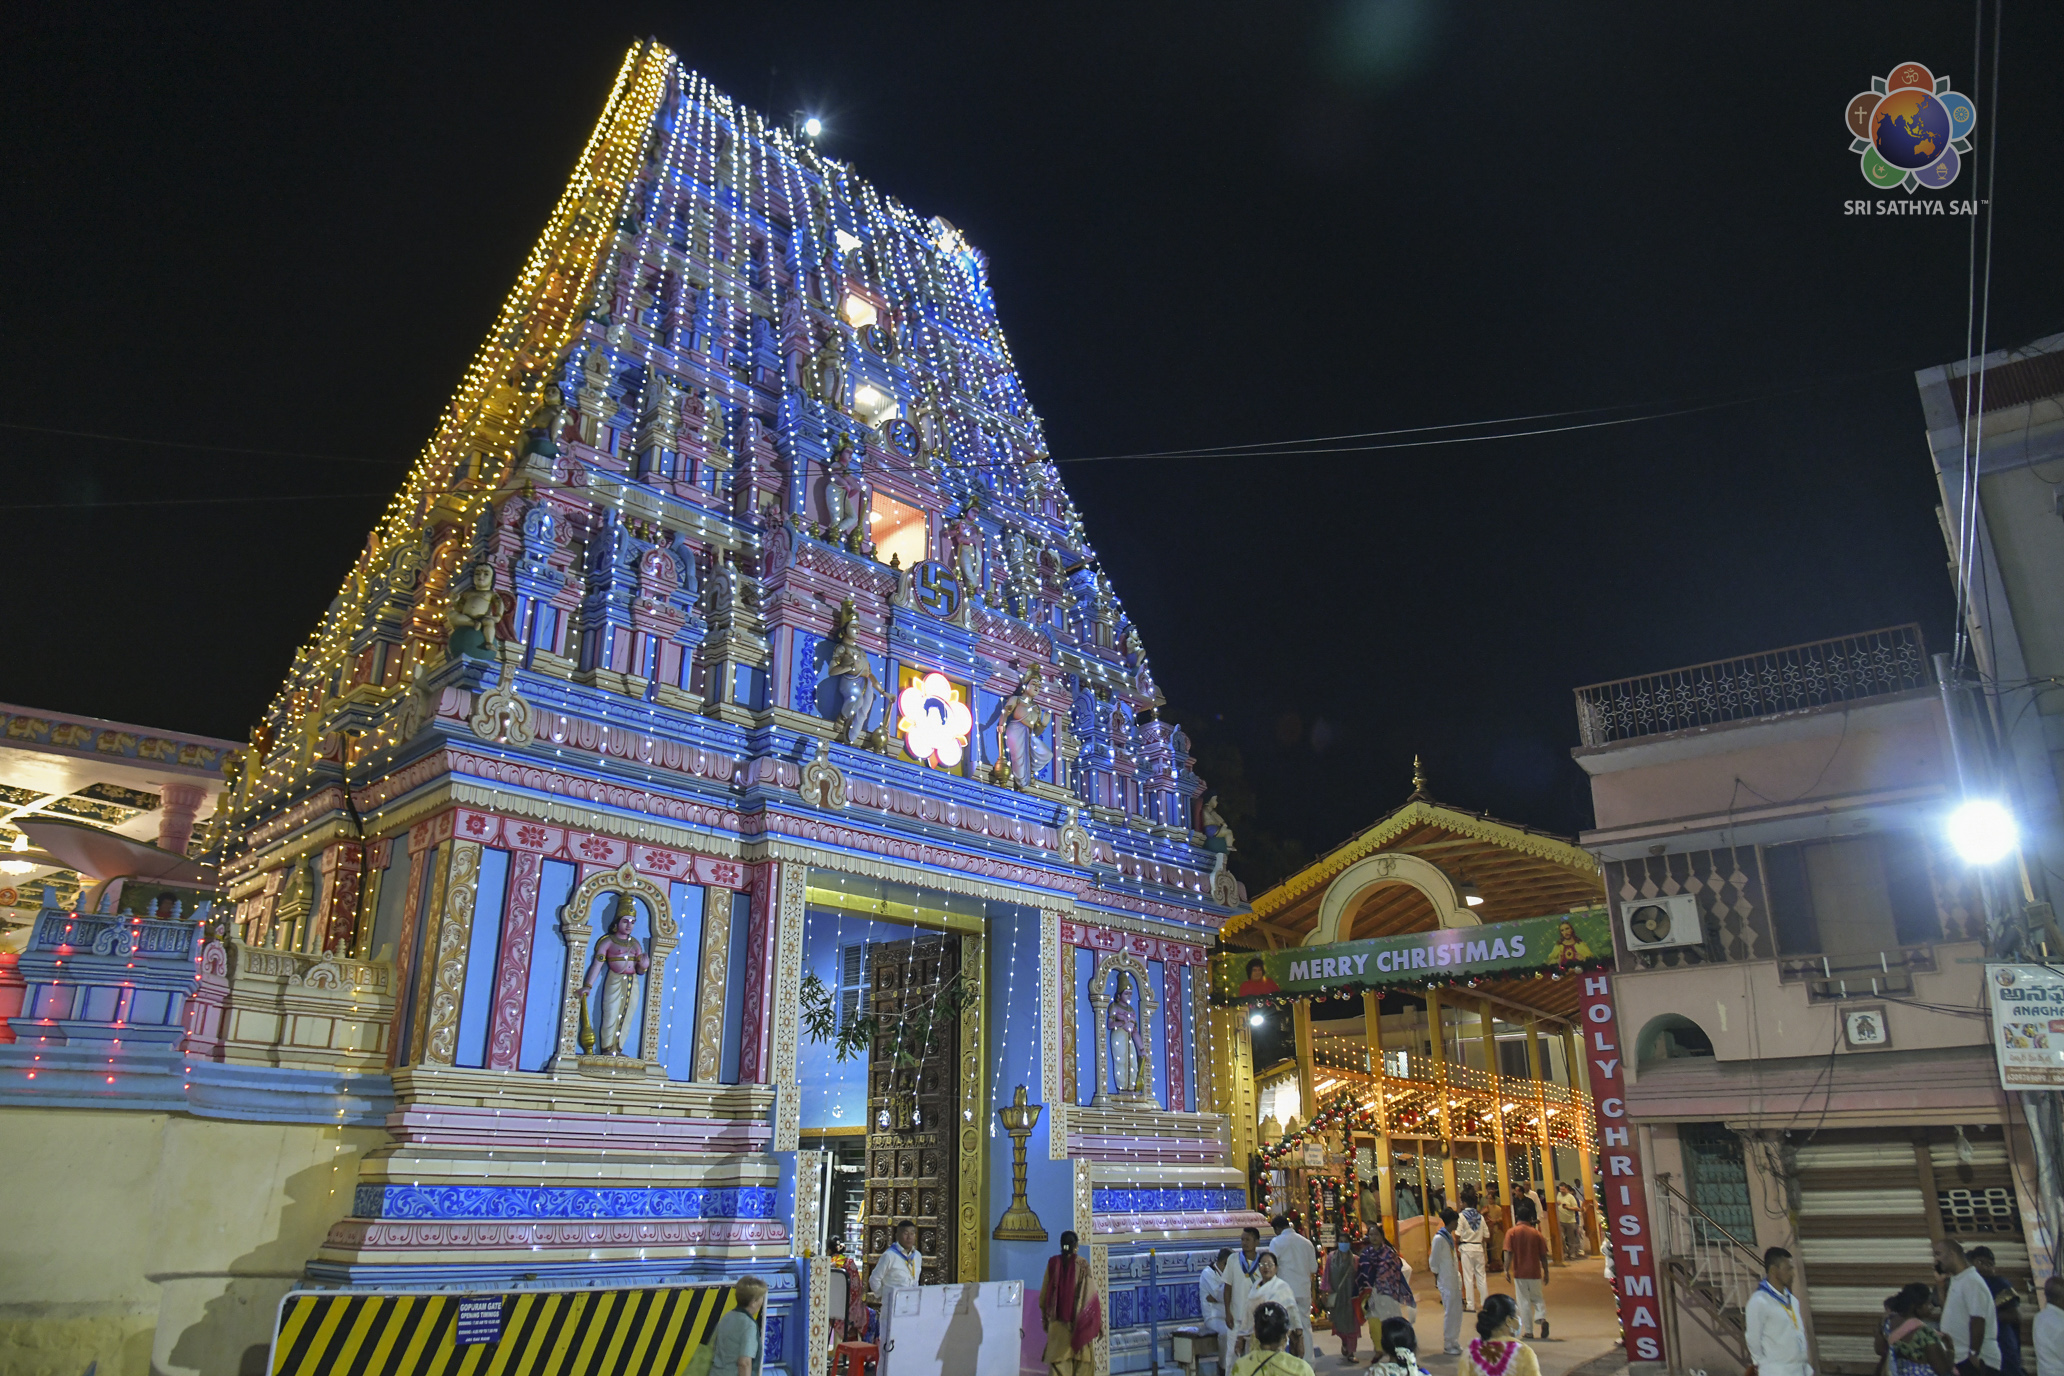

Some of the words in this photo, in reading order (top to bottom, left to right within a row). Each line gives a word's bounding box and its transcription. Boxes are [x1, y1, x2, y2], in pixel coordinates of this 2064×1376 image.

[1288, 953, 1369, 982] MERRY
[1376, 935, 1526, 971] CHRISTMAS
[1584, 976, 1619, 1080] HOLY
[1601, 1097, 1660, 1360] CHRISTMAS
[460, 1303, 487, 1311] GOPURAM
[487, 1302, 501, 1310] GATE
